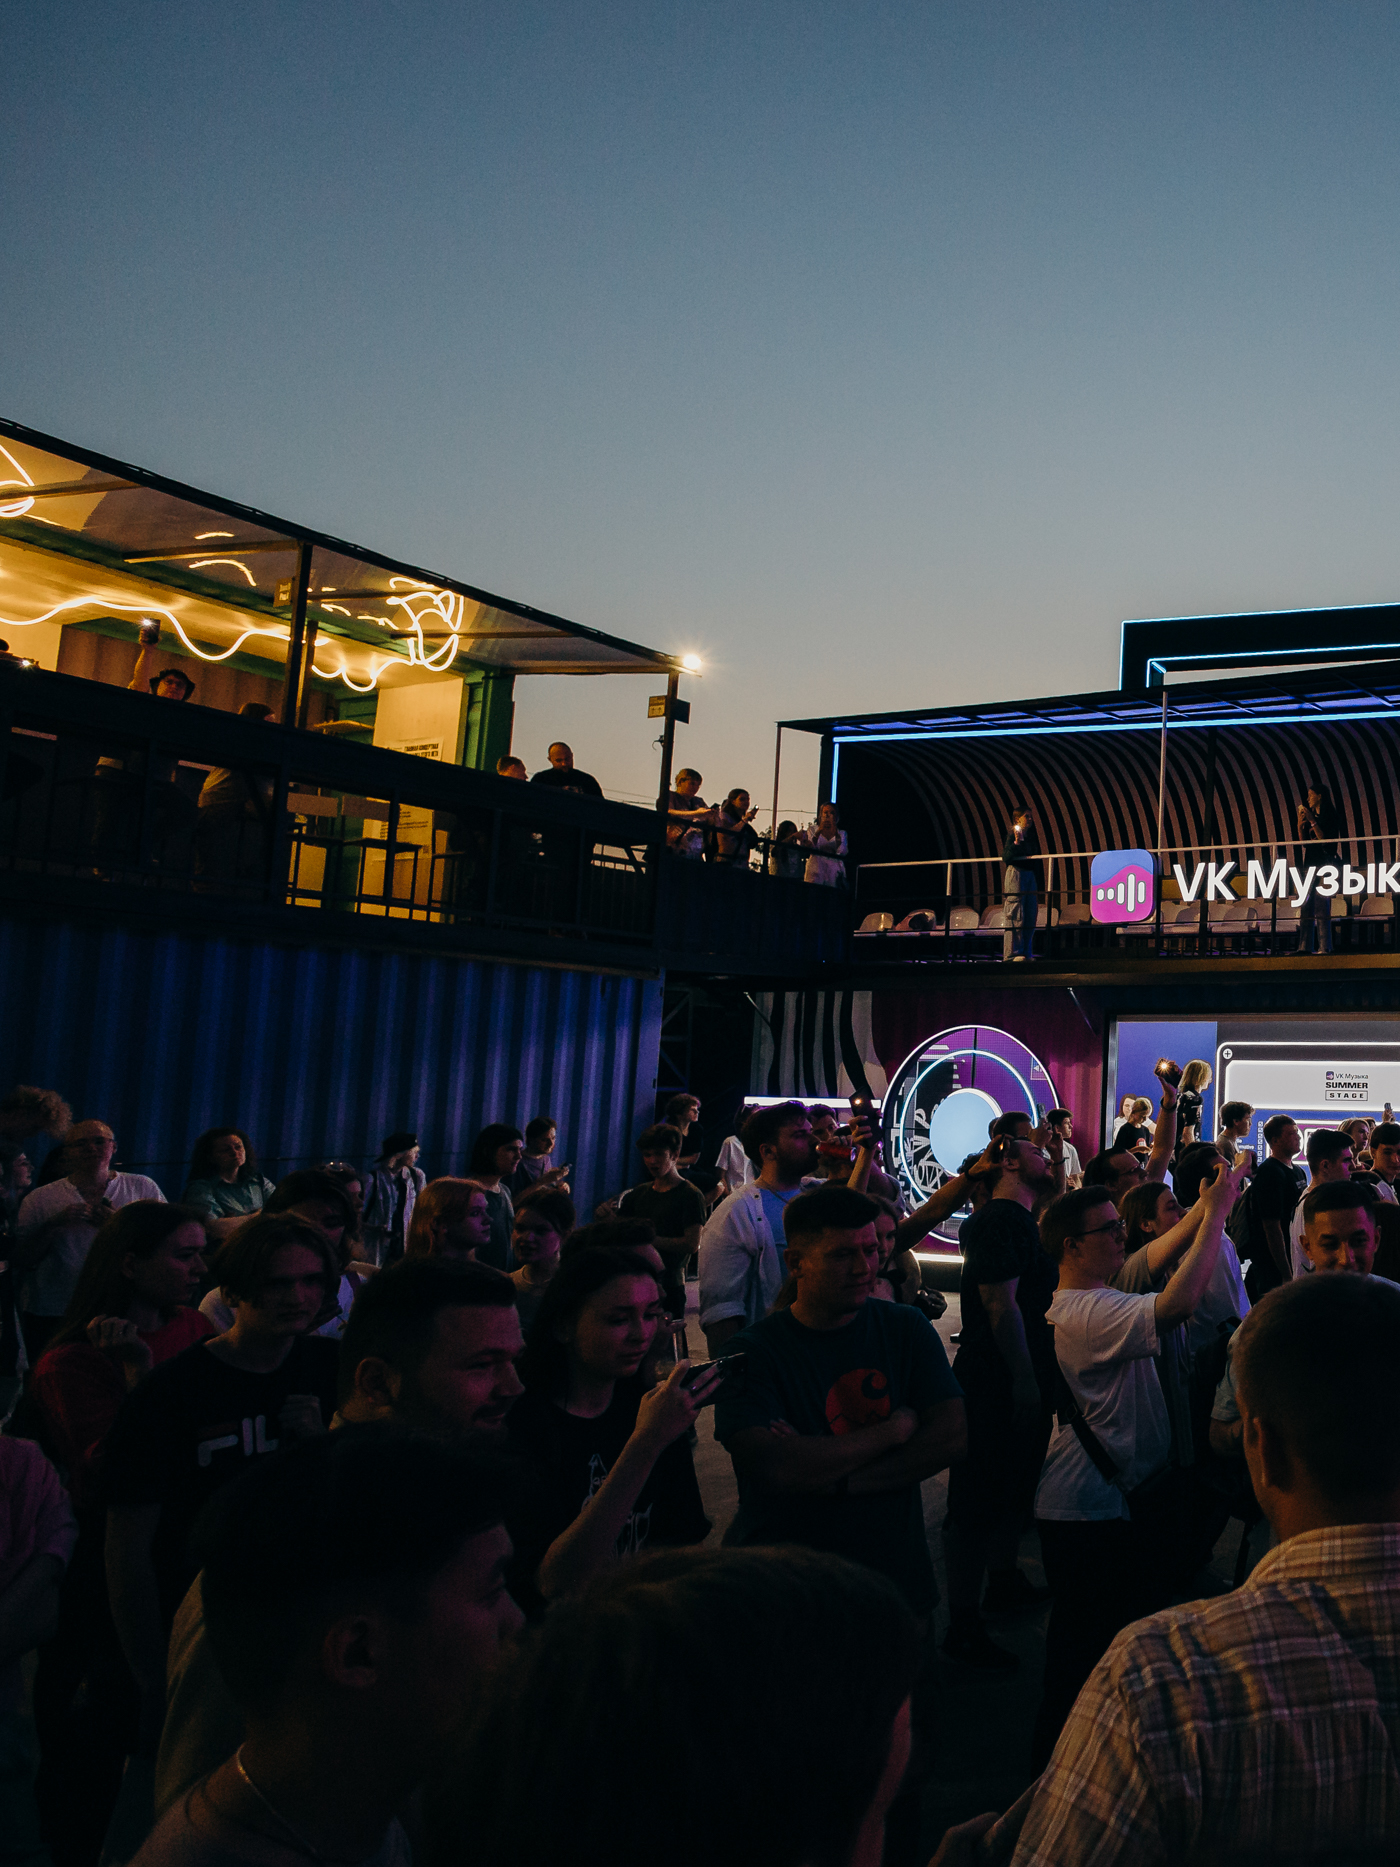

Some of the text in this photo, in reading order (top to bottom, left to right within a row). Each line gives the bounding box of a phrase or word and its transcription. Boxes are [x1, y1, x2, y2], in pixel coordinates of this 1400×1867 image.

[1173, 861, 1237, 902] VK
[1325, 1081, 1368, 1089] SUMMER
[198, 1414, 279, 1467] FIL
